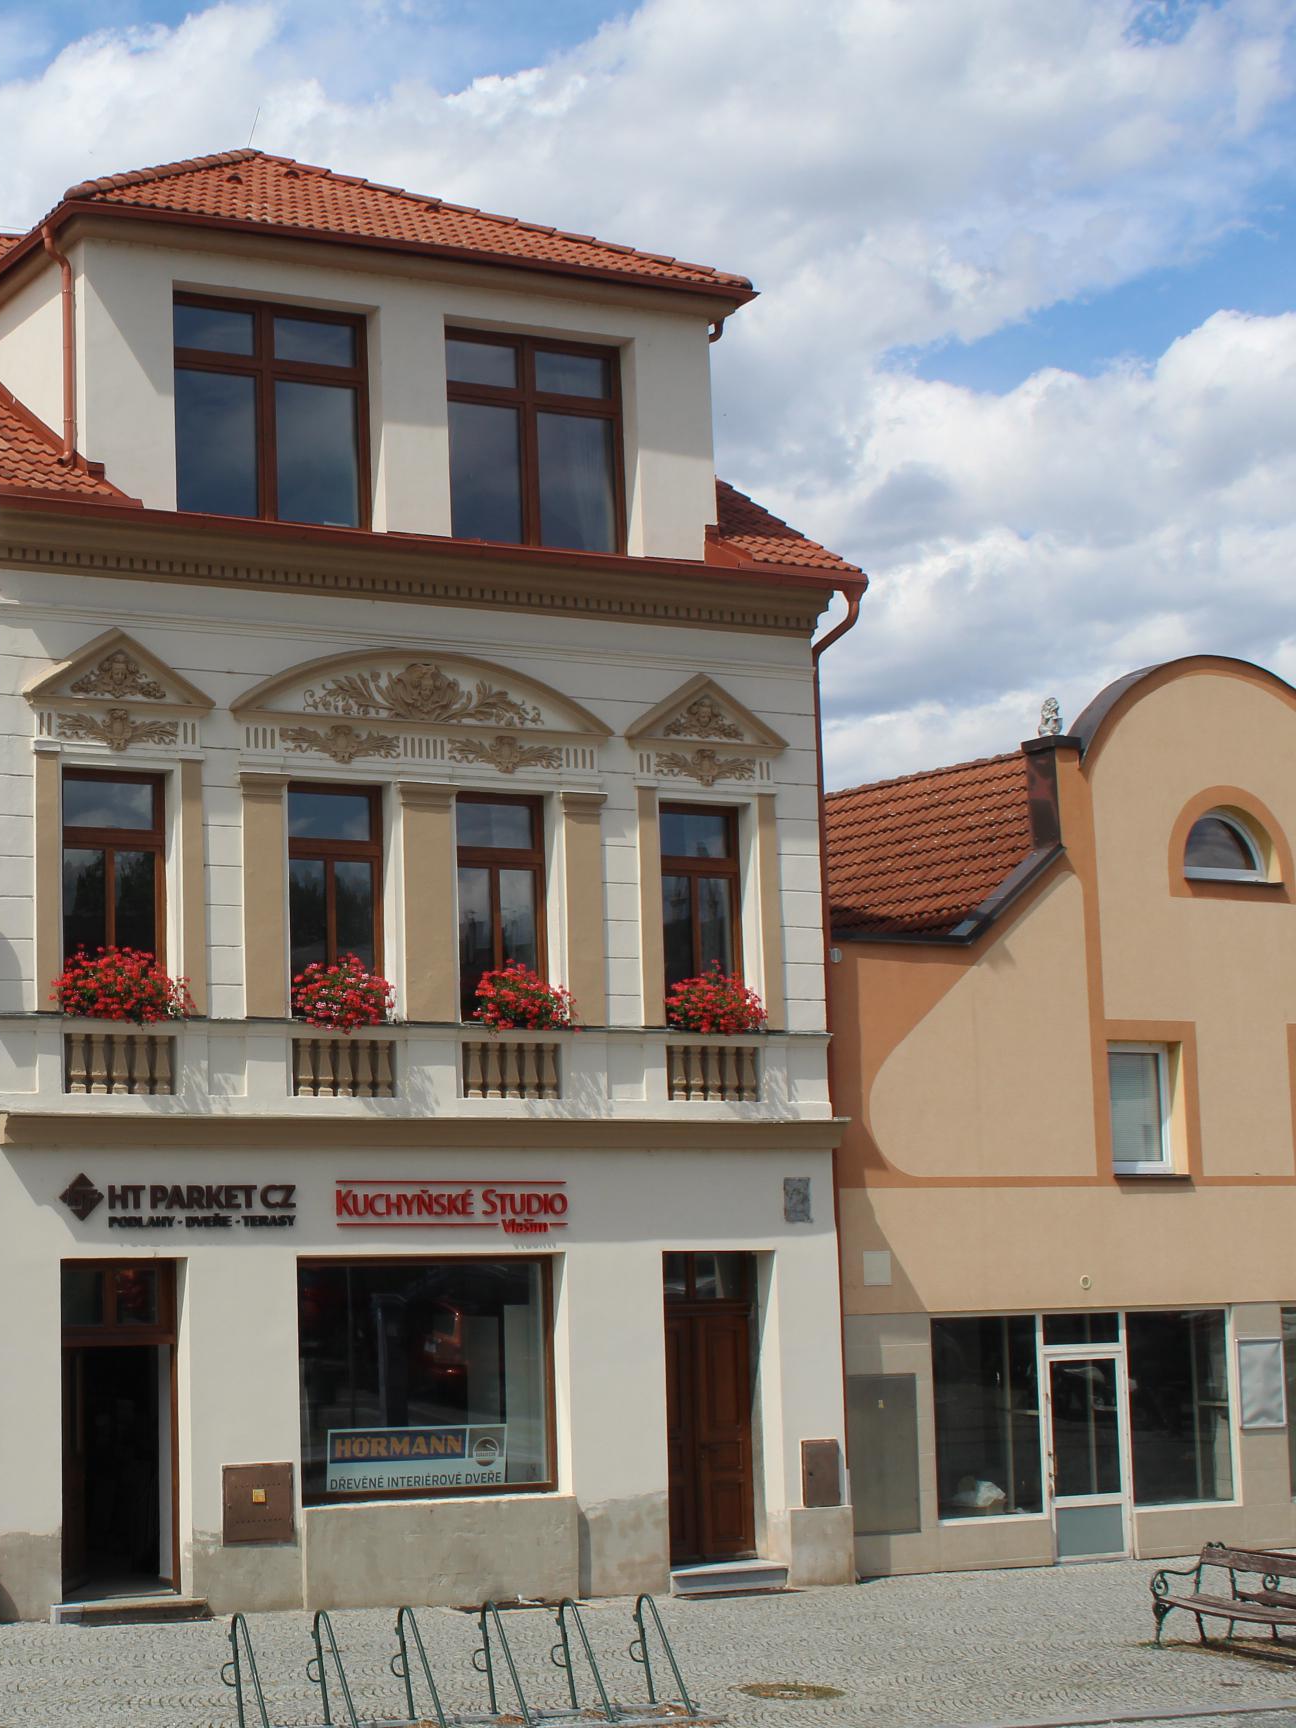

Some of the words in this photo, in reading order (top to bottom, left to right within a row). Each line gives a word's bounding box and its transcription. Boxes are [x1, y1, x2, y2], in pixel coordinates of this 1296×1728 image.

[107, 1185, 146, 1210] HT
[149, 1185, 257, 1210] PARKET
[260, 1184, 297, 1209] CZ
[335, 1189, 475, 1217] KUCHYŇSKÉ
[481, 1189, 568, 1217] STUDIO
[108, 1215, 176, 1228] PODLAHY
[185, 1212, 233, 1228] DVEŘE
[242, 1215, 297, 1227] TERASY
[329, 1475, 384, 1491] DŘEVĚNÉ
[387, 1471, 462, 1489] INTERIÉROVÉ
[465, 1469, 502, 1484] DVEŘE
